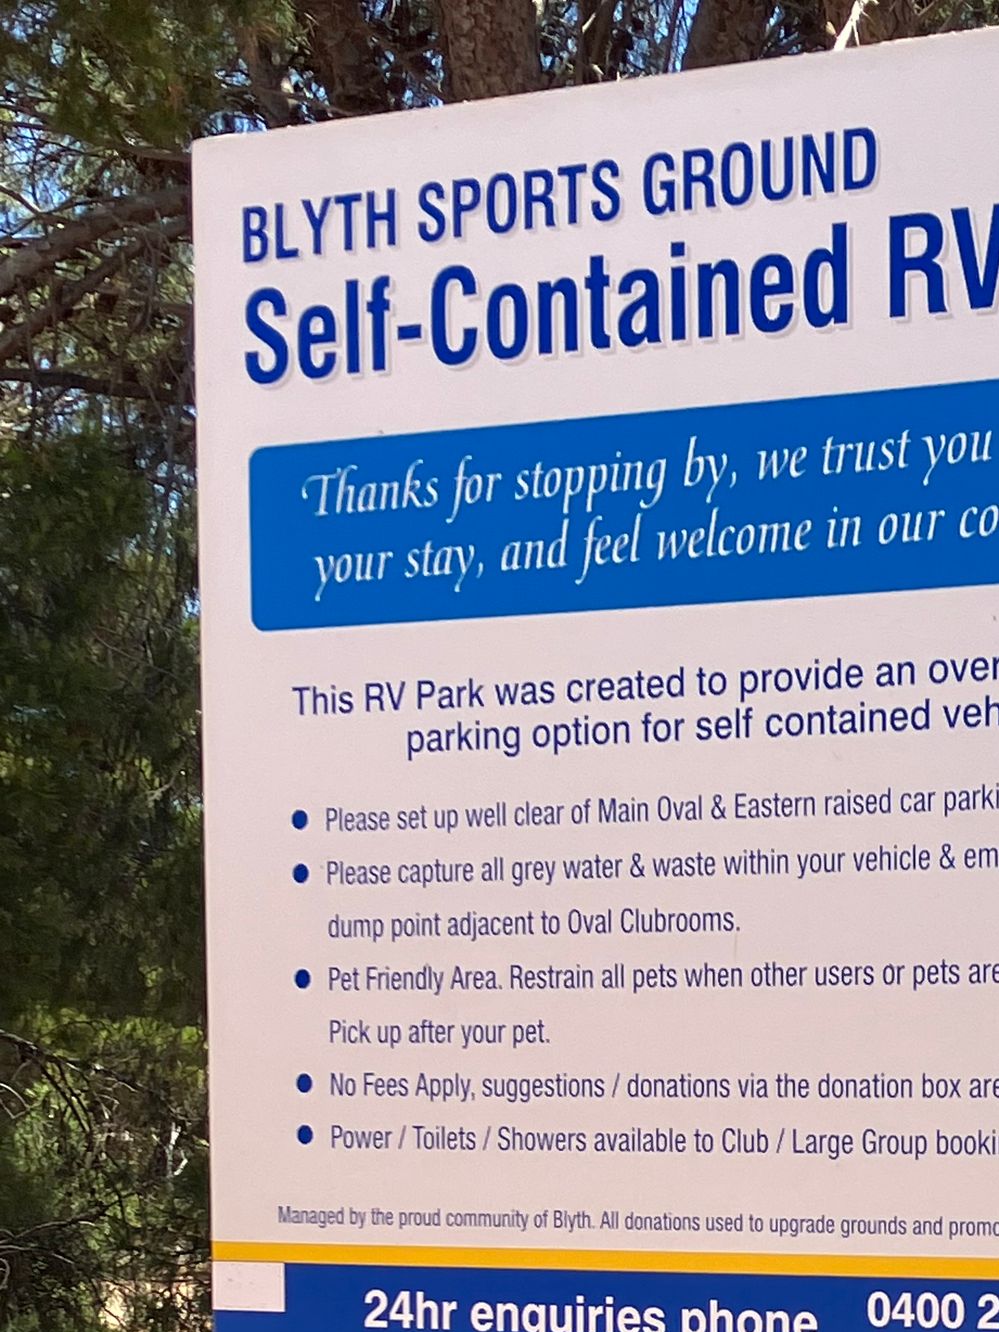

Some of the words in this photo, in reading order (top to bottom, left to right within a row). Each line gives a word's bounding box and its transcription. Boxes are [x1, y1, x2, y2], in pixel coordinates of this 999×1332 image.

[243, 189, 395, 263] BLYTH
[419, 160, 620, 242] SPORTS
[644, 128, 876, 215] GROUND
[246, 222, 847, 384] Self-Contained
[302, 460, 438, 515] Thanks
[446, 456, 501, 523] for
[515, 452, 666, 514] stopping
[684, 436, 736, 503] by,
[758, 447, 807, 480] we
[823, 430, 910, 474] trust
[922, 431, 991, 486] you
[315, 552, 393, 601] your
[405, 541, 483, 592] stay,
[501, 518, 572, 571] and
[581, 513, 641, 584] feel
[658, 508, 811, 560] welcome
[827, 507, 860, 548] in
[879, 510, 945, 544] our
[292, 685, 354, 715] This
[365, 681, 406, 712] RV
[417, 678, 484, 710] Park
[495, 681, 555, 706] was
[567, 666, 684, 703] created
[696, 667, 727, 696] to
[740, 657, 864, 703] provide
[876, 661, 915, 687] an
[407, 720, 520, 761] parking
[532, 715, 630, 755] option
[641, 712, 685, 743] for
[696, 707, 753, 741] self
[766, 698, 930, 738] contained
[326, 808, 390, 832] Please
[397, 805, 427, 830] set
[434, 809, 458, 833] up
[465, 802, 506, 827] well
[514, 801, 564, 826] clear
[571, 798, 591, 824] of
[599, 797, 648, 823] Main
[658, 795, 702, 821] Oval
[711, 794, 727, 820] &
[735, 793, 815, 819] Eastern
[825, 787, 891, 816] raised
[900, 792, 936, 813] car
[328, 914, 384, 943] dump
[392, 913, 441, 942] point
[448, 911, 534, 942] adjacent
[541, 911, 560, 935] to
[568, 909, 611, 934] Oval
[621, 908, 740, 933] Clubrooms.
[330, 1020, 371, 1043] Pick
[378, 1025, 401, 1049] up
[409, 1019, 455, 1043] after
[461, 1025, 506, 1049] your
[513, 1020, 550, 1048] pet.
[278, 1206, 344, 1228] Managed
[349, 1207, 366, 1229] by
[371, 1208, 394, 1225] the
[399, 1208, 441, 1229] proud
[446, 1209, 529, 1232] community
[533, 1210, 548, 1228] of
[553, 1210, 595, 1233] Blyth.
[600, 1211, 619, 1229] All
[625, 1212, 700, 1231] donations
[706, 1214, 743, 1232] used
[749, 1214, 763, 1232] to
[769, 1215, 835, 1237] upgrade
[841, 1216, 907, 1238] grounds
[913, 1216, 943, 1236] and
[365, 1290, 457, 1330] 24hr
[868, 1292, 964, 1329] 0400
